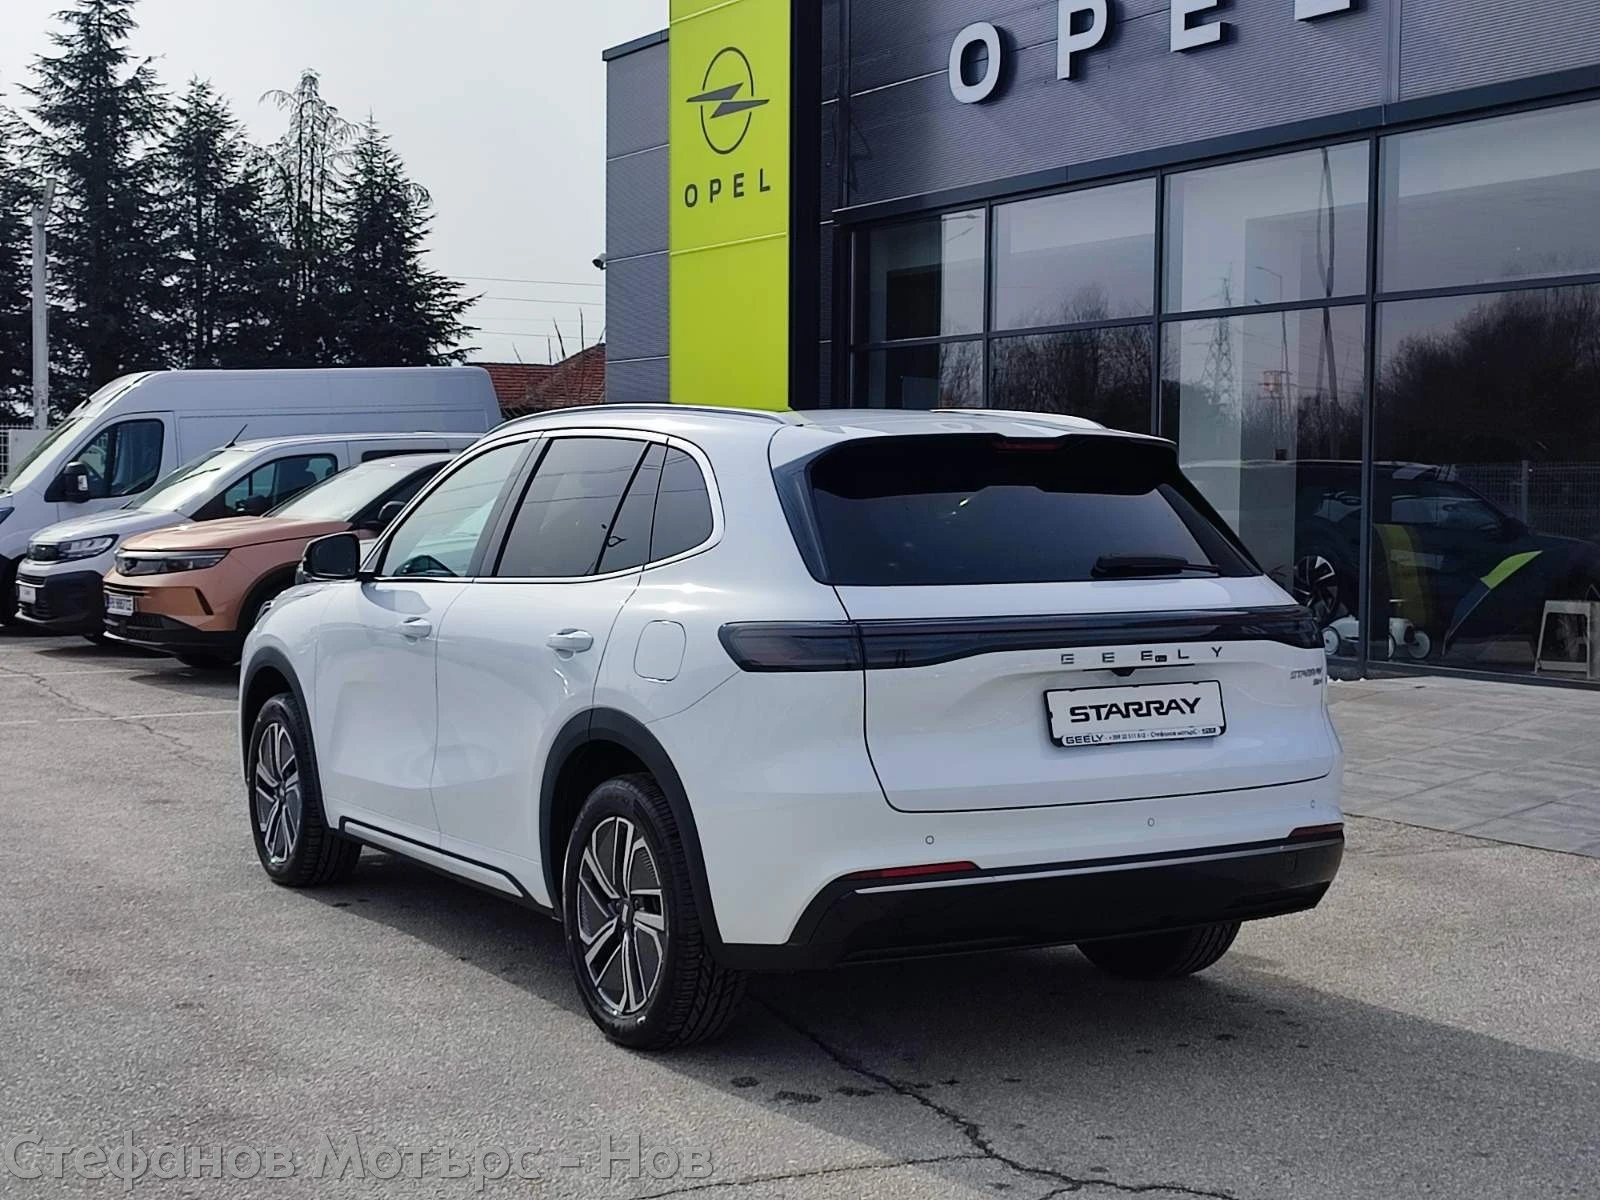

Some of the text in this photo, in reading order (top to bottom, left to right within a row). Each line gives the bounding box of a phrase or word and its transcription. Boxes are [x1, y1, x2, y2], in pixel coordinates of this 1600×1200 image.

[948, 0, 1351, 104] OPE
[684, 168, 771, 208] OPEL
[1061, 646, 1223, 665] GEELY
[1069, 697, 1201, 723] STARRAY
[1065, 733, 1104, 745] GEELY
